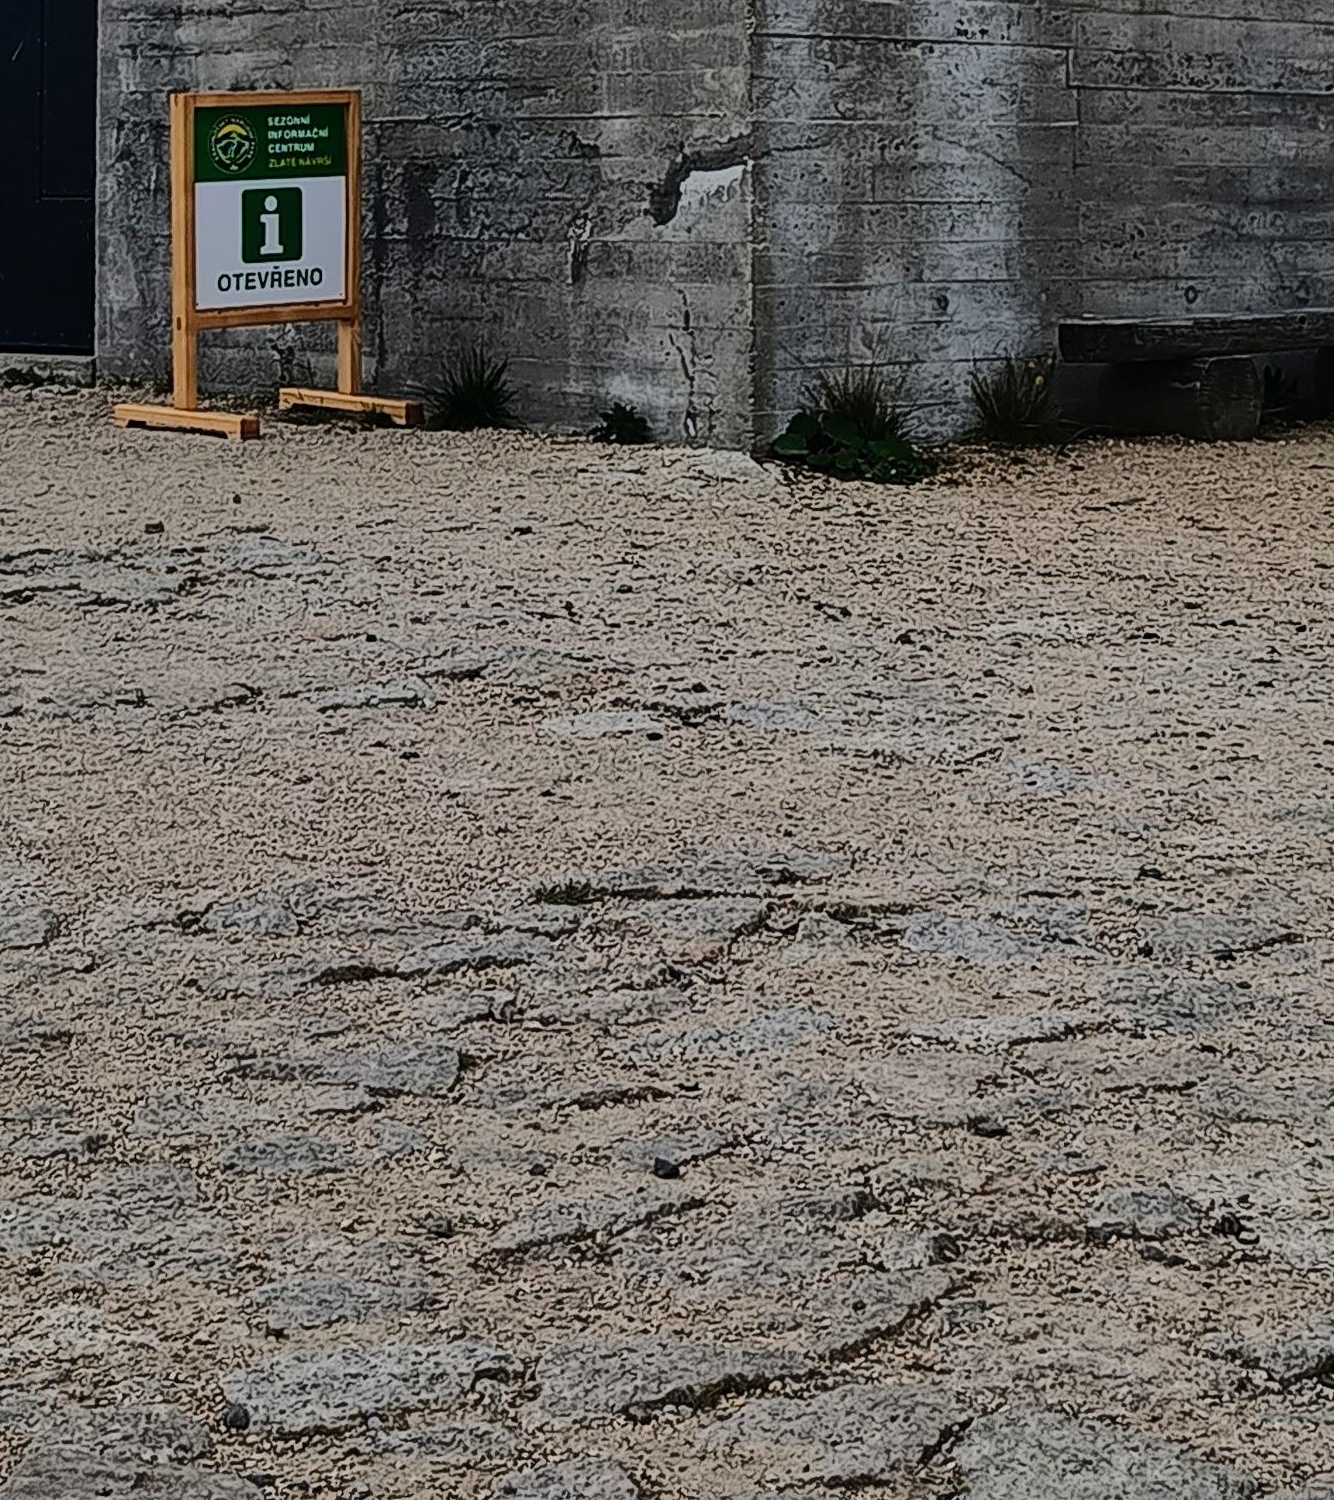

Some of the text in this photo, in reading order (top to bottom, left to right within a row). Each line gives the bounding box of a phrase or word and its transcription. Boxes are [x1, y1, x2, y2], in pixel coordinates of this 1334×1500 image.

[268, 126, 329, 140] INFORMAČNÍ
[268, 142, 315, 154] CENTRUM
[217, 265, 323, 292] OTEVŘENO
